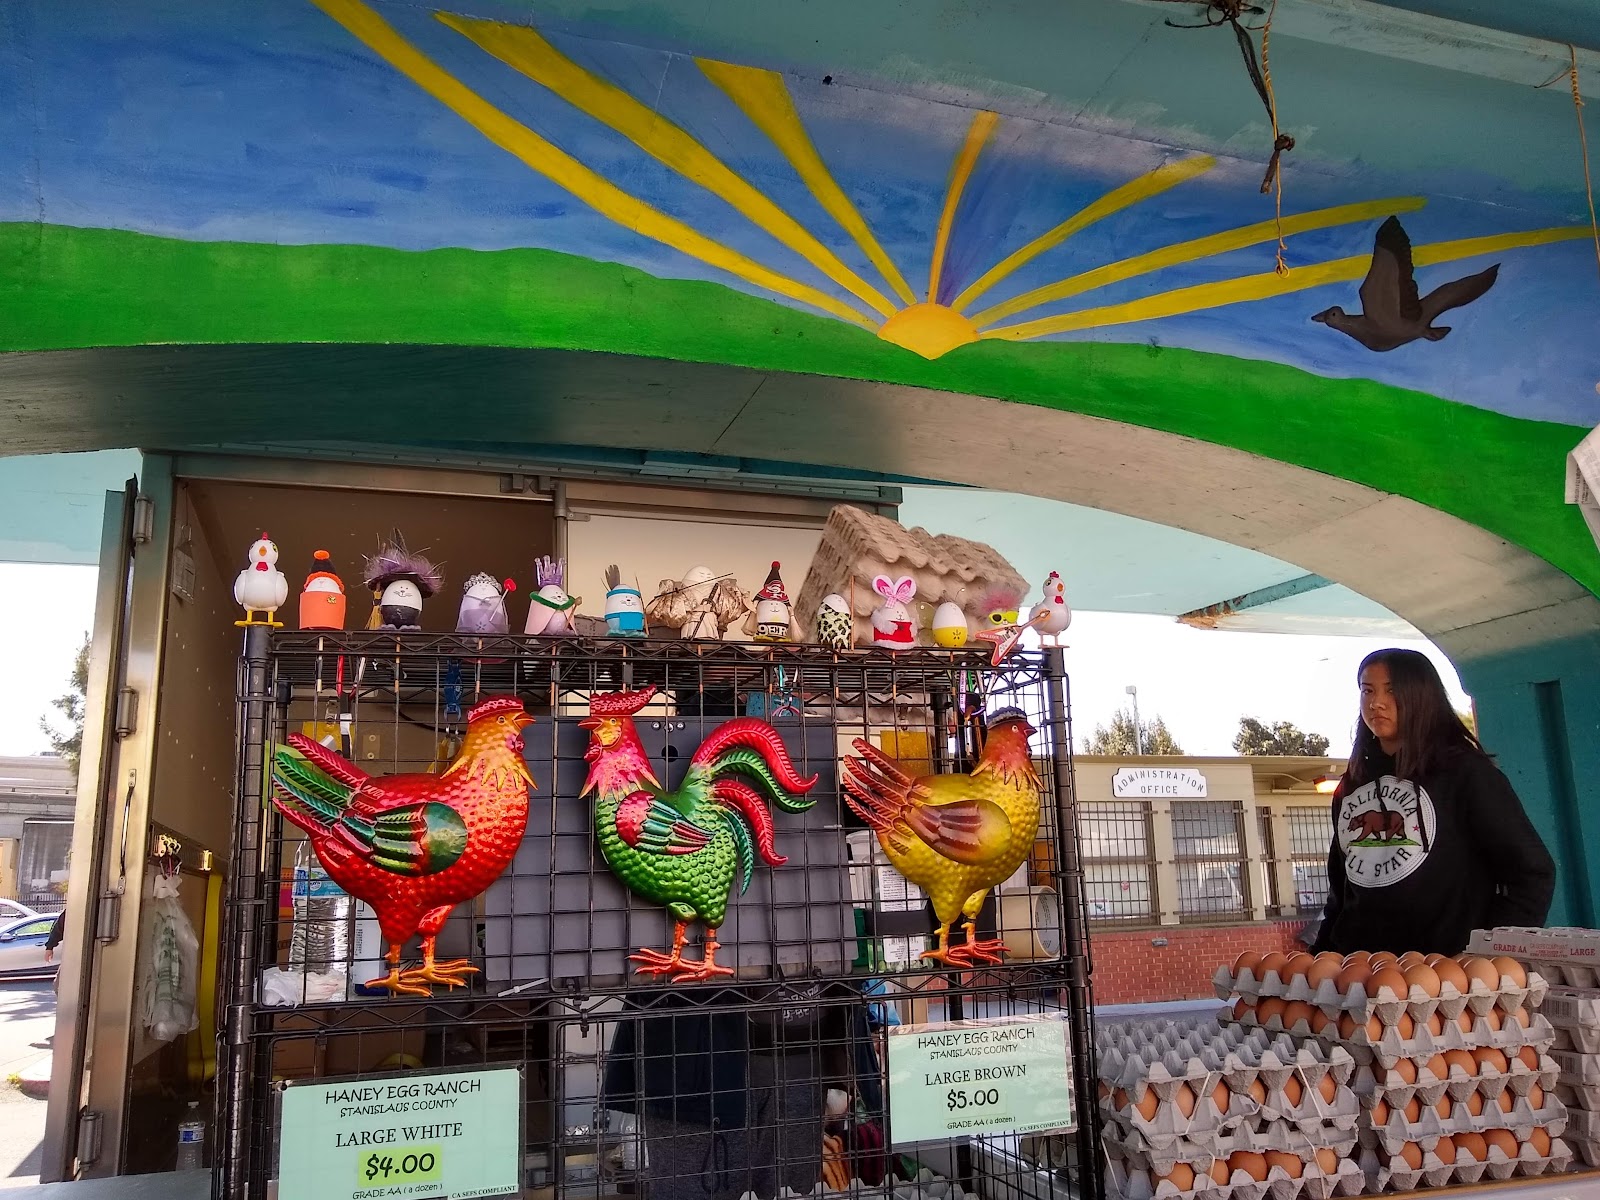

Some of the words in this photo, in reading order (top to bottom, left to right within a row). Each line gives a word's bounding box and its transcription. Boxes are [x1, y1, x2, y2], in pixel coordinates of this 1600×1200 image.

[1117, 770, 1204, 793] ADMINISTRATION
[1140, 785, 1178, 795] OFFICE
[1374, 847, 1412, 877] STAR
[1493, 943, 1516, 953] GRADE
[1518, 945, 1527, 953] AA
[1570, 948, 1596, 956] LARGE
[918, 1033, 962, 1049] HANEY
[964, 1032, 989, 1045] EGG
[990, 1027, 1035, 1042] RANCH
[930, 1046, 982, 1060] STANISLAUS
[983, 1044, 1018, 1055] COUNTY
[925, 1070, 971, 1086] LARGE
[975, 1064, 1027, 1081] BROWN
[325, 1086, 383, 1104] HANEY
[387, 1084, 420, 1099] EGG
[424, 1079, 481, 1096] RANCH
[947, 1088, 999, 1111] $5.00
[340, 1101, 409, 1118] STANISLAUS
[412, 1098, 457, 1111] COUNTY
[336, 1128, 396, 1147] LARGE
[401, 1122, 463, 1141] WHITE
[947, 1120, 972, 1129] GRADE
[1040, 1120, 1069, 1129] COMPLIANT
[365, 1153, 435, 1181] $4.00
[352, 1188, 385, 1200] GRADE
[387, 1187, 402, 1196] AA
[478, 1185, 517, 1196] COMPLIANT
